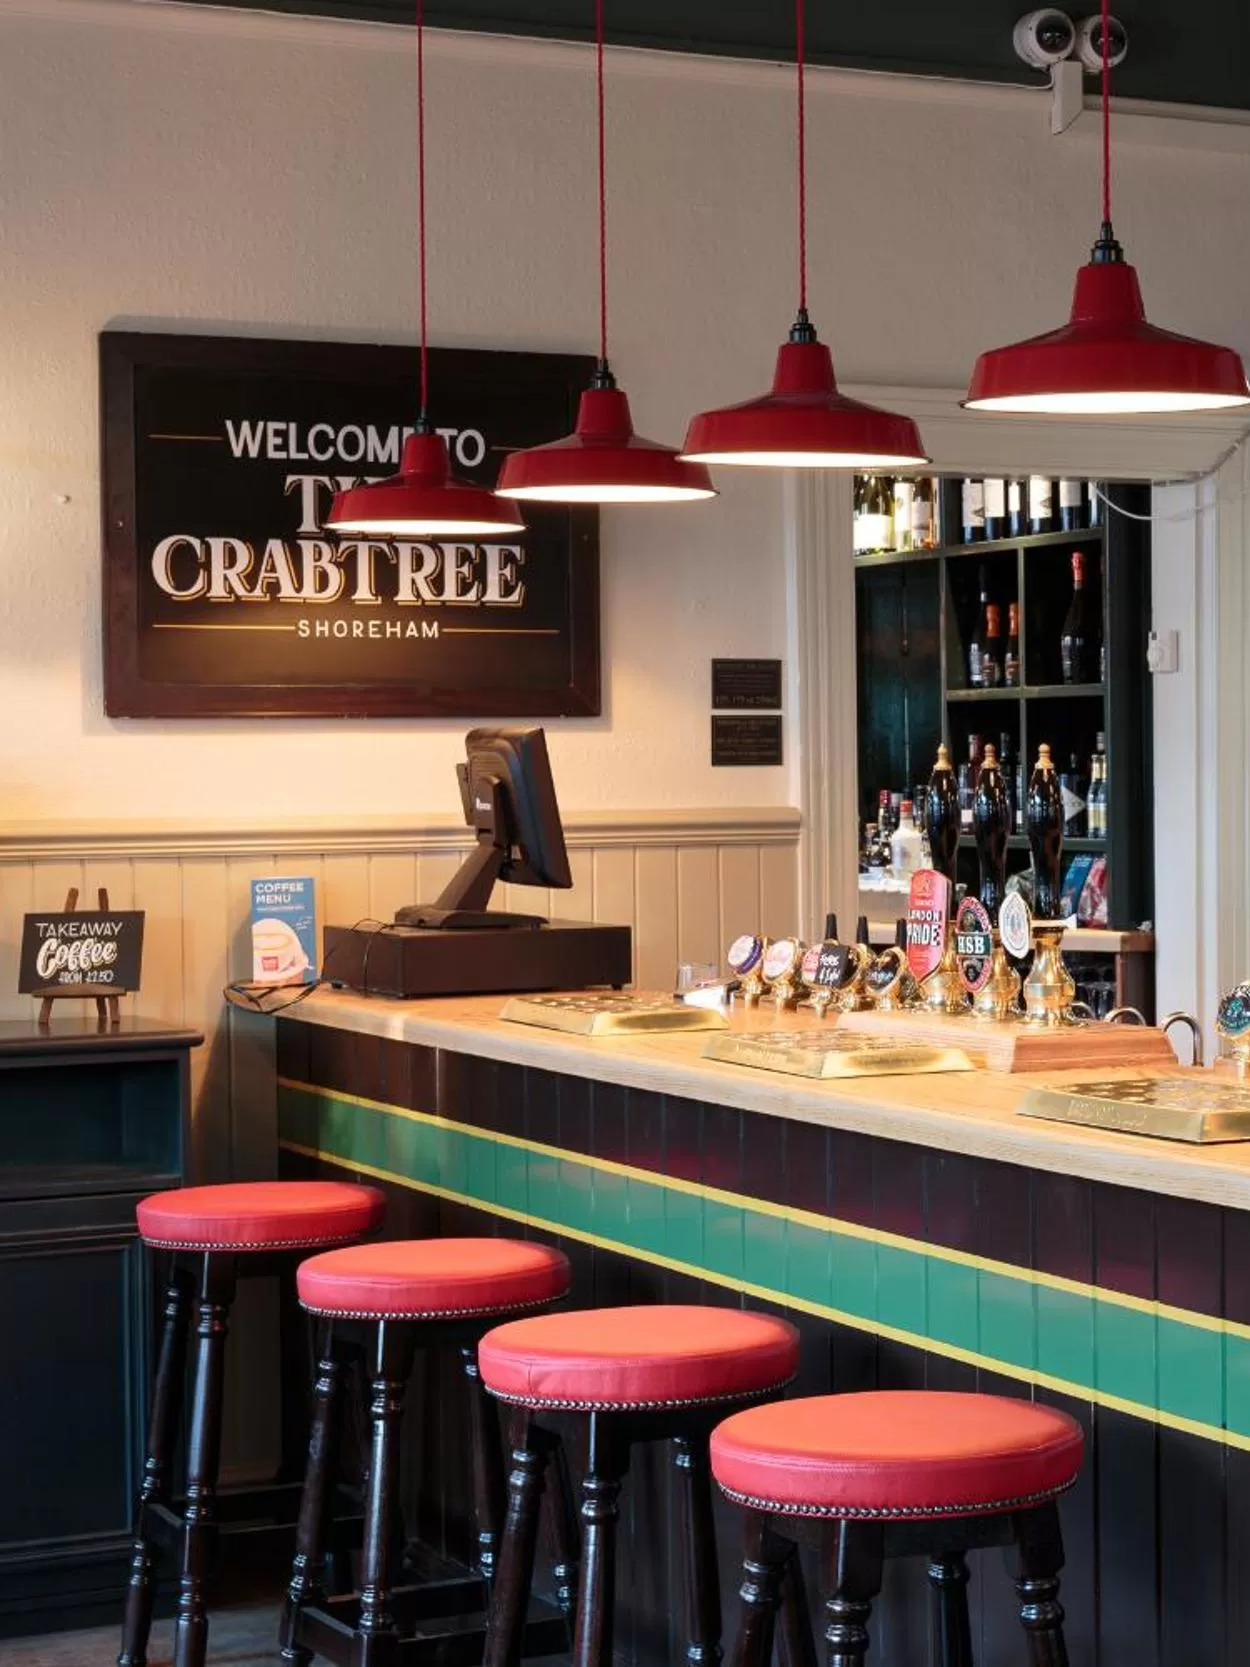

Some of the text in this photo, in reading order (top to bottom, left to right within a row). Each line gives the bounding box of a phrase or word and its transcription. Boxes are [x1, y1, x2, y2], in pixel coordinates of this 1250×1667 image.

[151, 534, 525, 606] CRABTREE
[297, 620, 440, 639] SHOREHAM
[255, 882, 304, 893] COFFEE
[255, 894, 292, 905] MENU
[907, 909, 941, 921] LONDON
[35, 921, 123, 938] TAKEAWAY
[906, 923, 942, 947] PRIDE
[957, 936, 985, 954] HSB
[36, 937, 119, 979] Coffee
